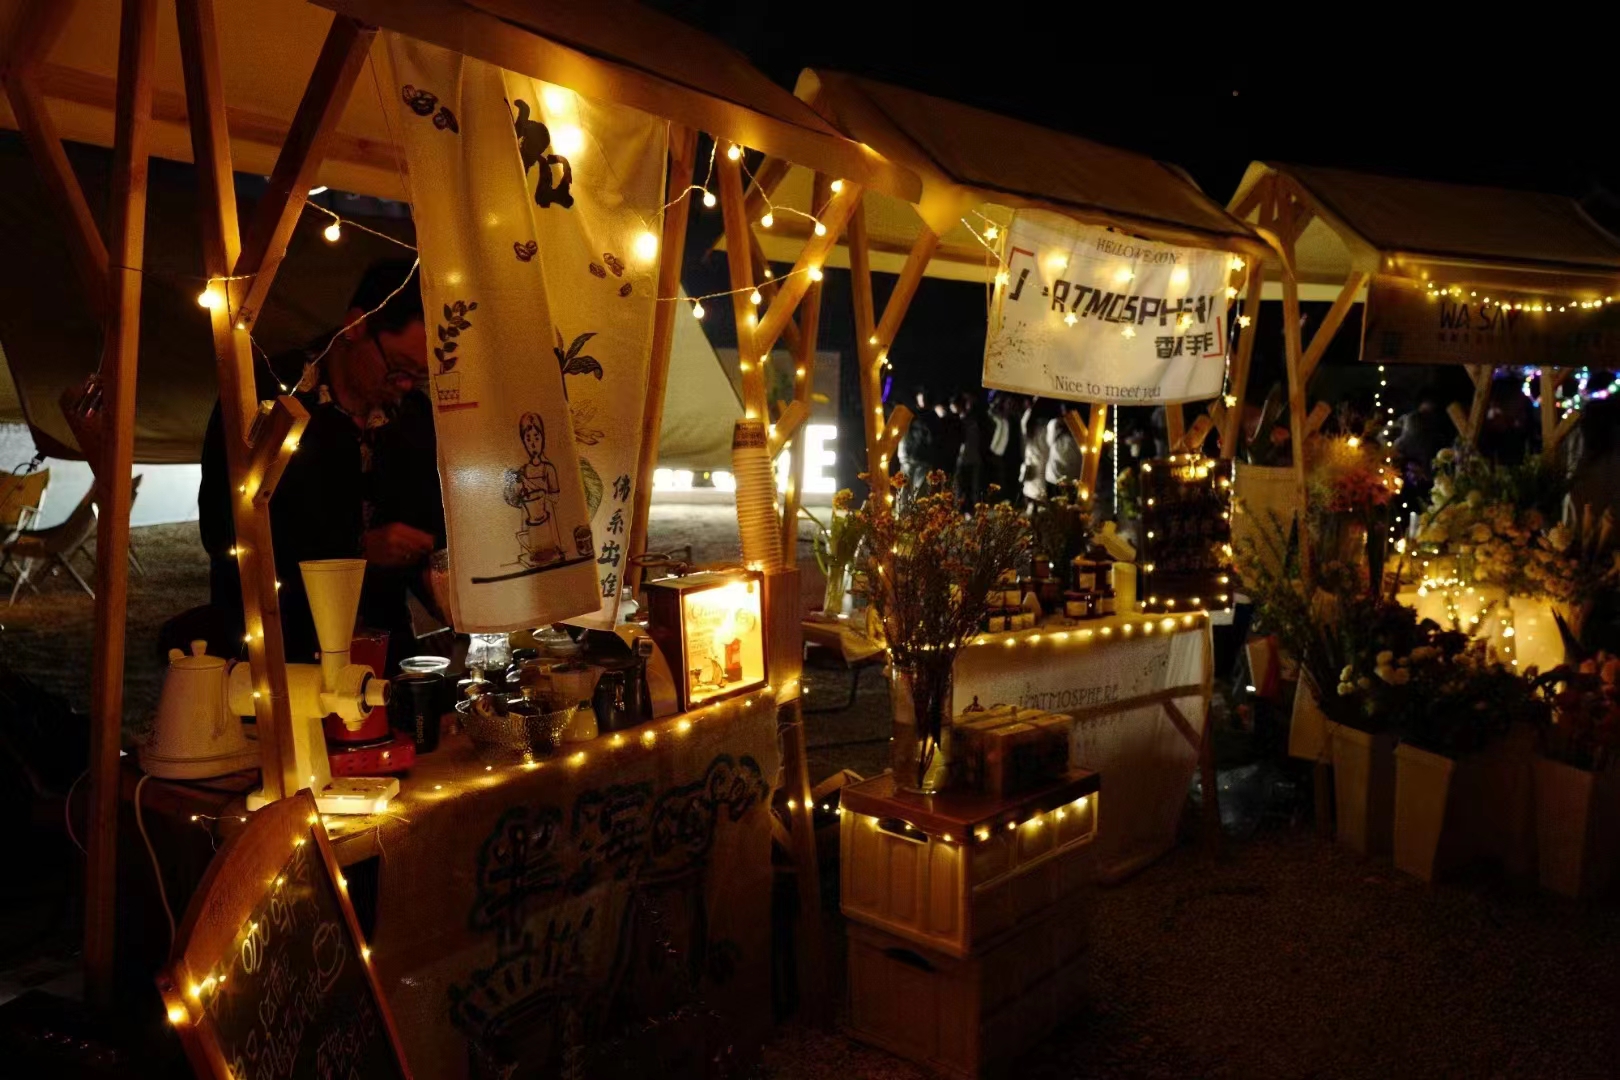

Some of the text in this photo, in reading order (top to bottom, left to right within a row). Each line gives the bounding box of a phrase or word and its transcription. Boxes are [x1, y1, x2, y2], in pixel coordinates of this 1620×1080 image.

[1055, 375, 1083, 393] Nice
[1087, 383, 1101, 396] to
[1105, 385, 1139, 398] meet
